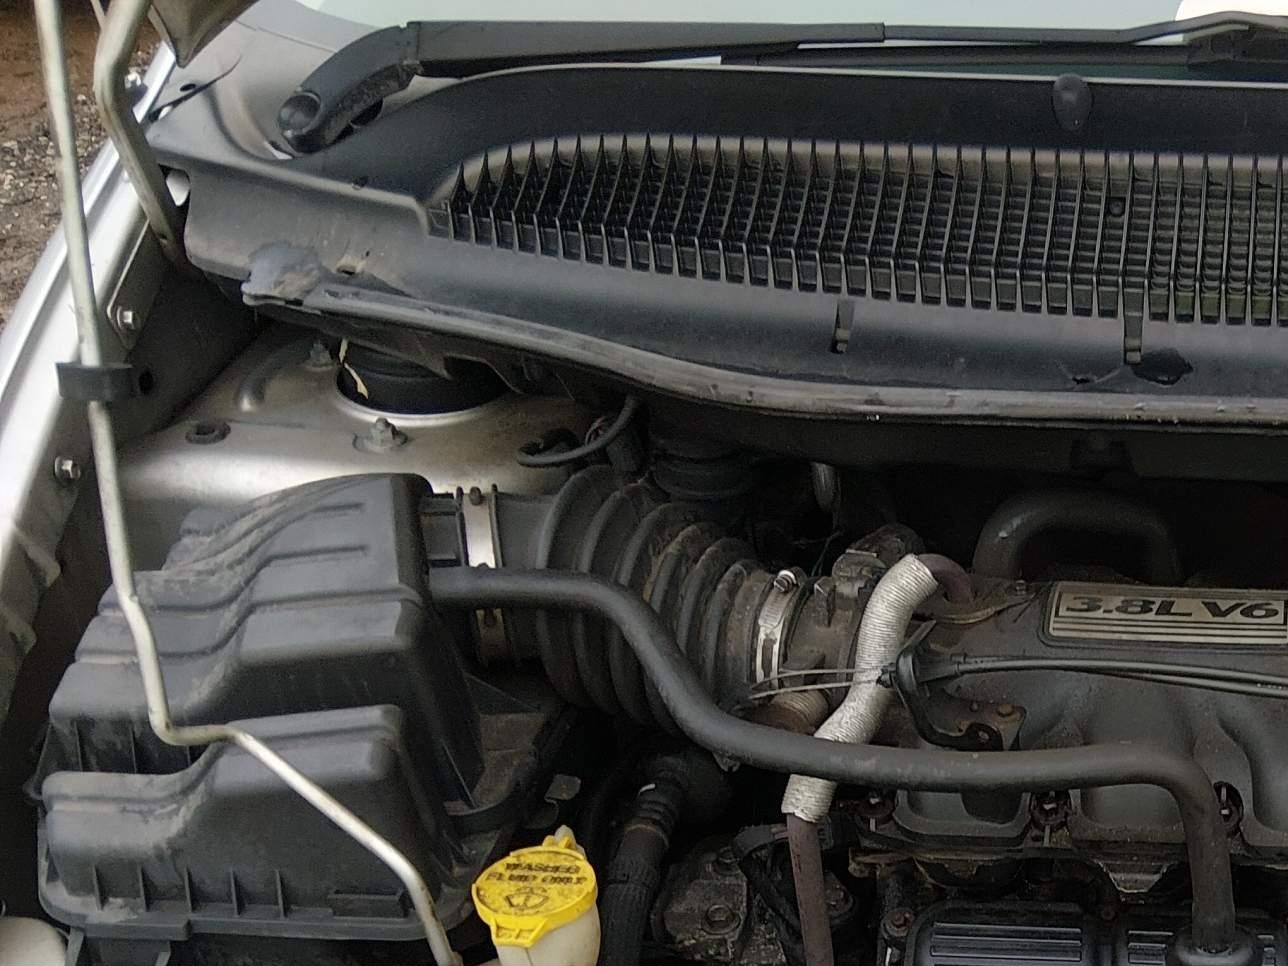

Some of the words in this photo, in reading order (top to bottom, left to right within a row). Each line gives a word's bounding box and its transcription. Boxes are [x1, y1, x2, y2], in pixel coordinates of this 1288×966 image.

[1066, 597, 1192, 618] 3.8L
[1202, 600, 1279, 620] V6
[504, 863, 581, 875] WASHER
